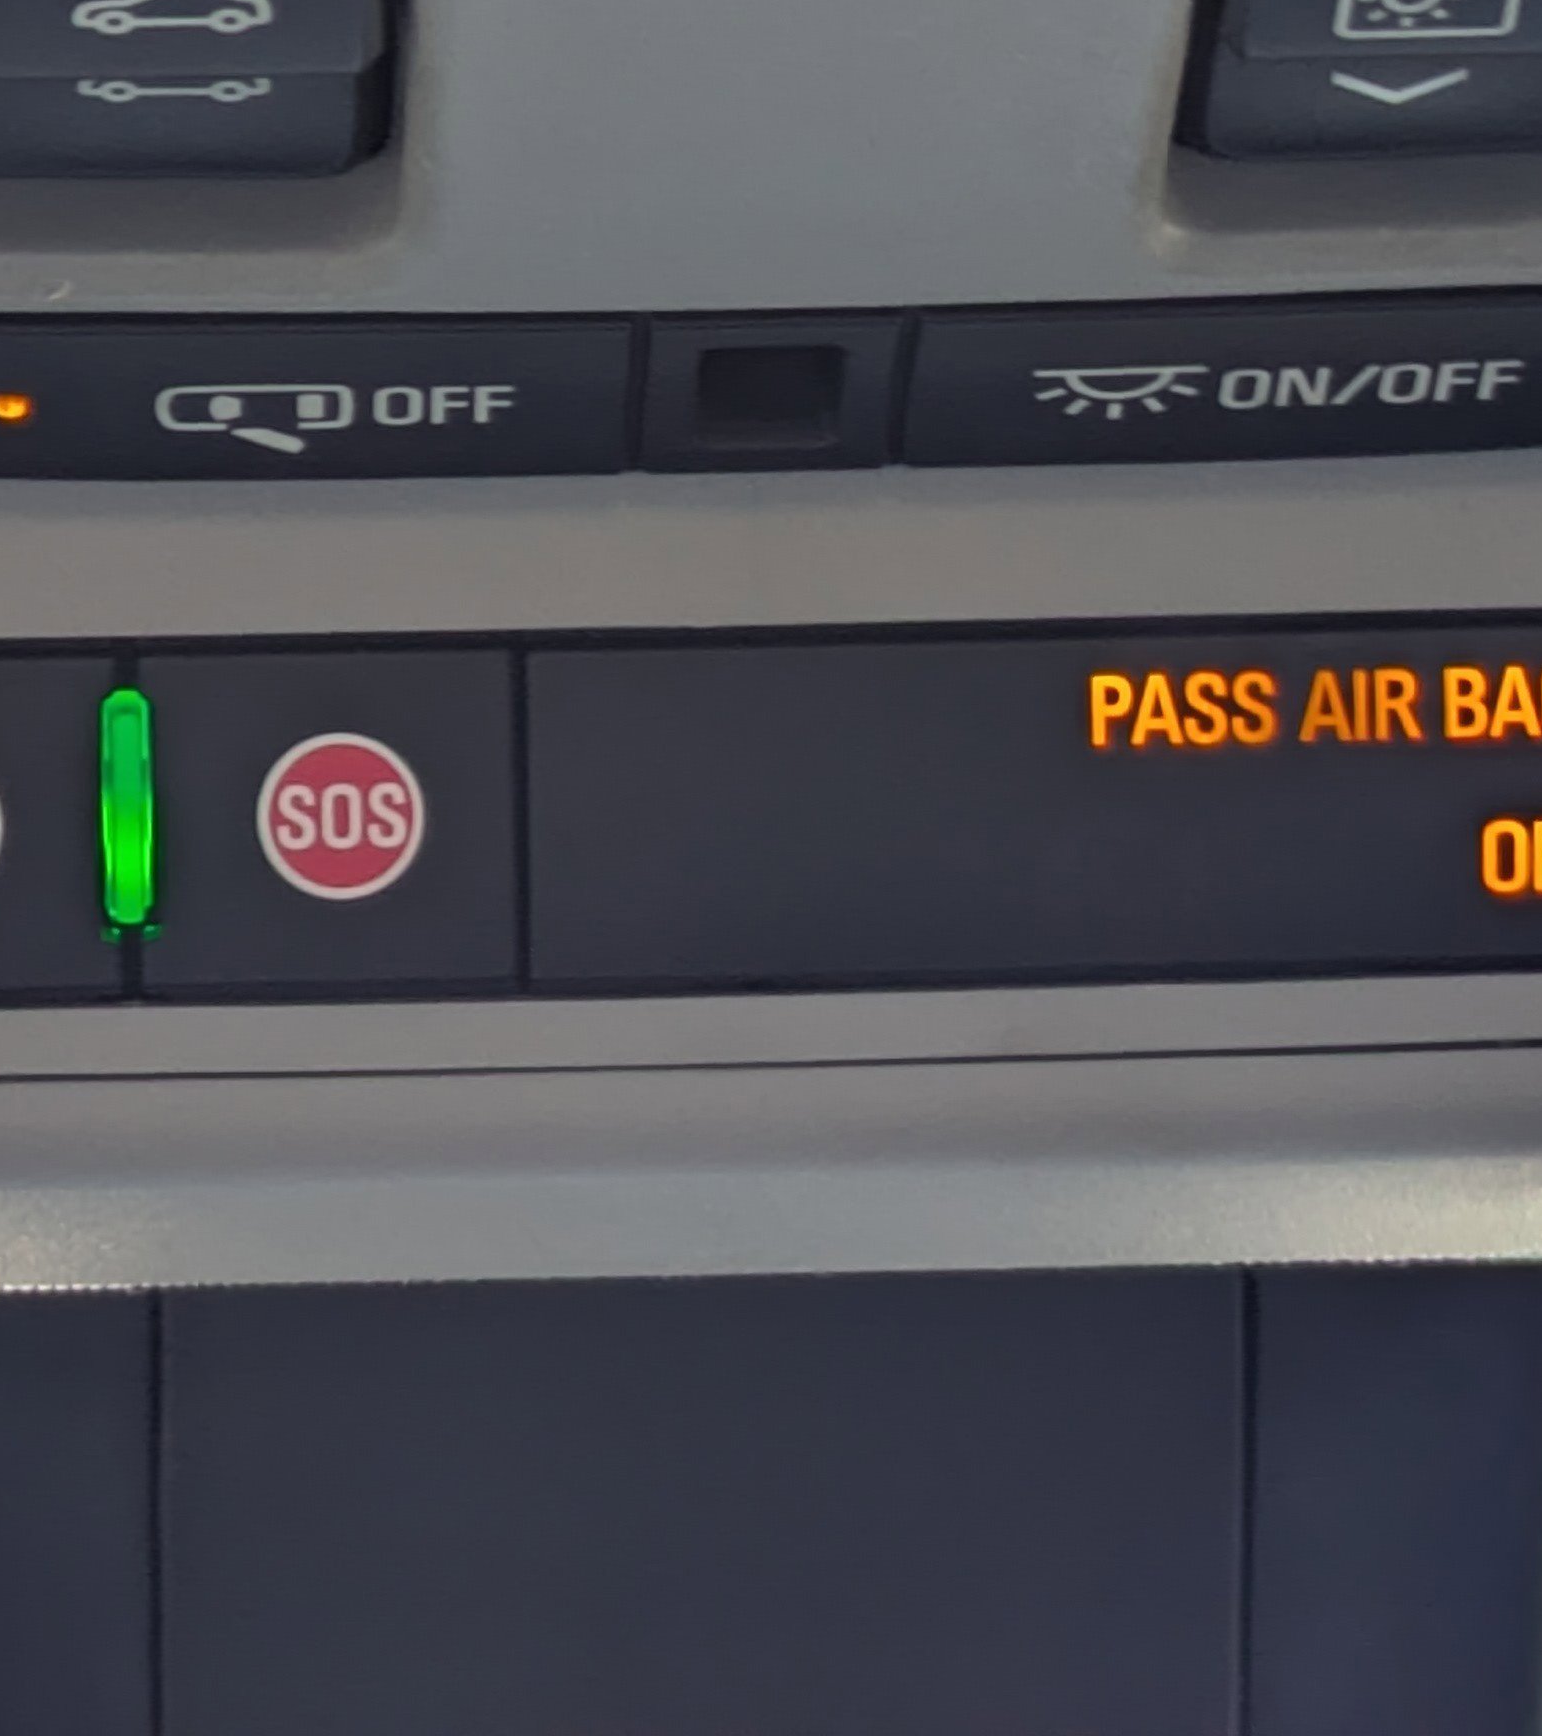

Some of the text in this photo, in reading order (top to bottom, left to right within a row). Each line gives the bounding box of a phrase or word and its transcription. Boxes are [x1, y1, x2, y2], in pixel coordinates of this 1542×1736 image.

[371, 383, 517, 427] OFF
[1216, 357, 1525, 411] ON/OFF
[1090, 671, 1277, 748] PASS
[1298, 668, 1423, 743] AIR
[274, 781, 410, 852] SOS
